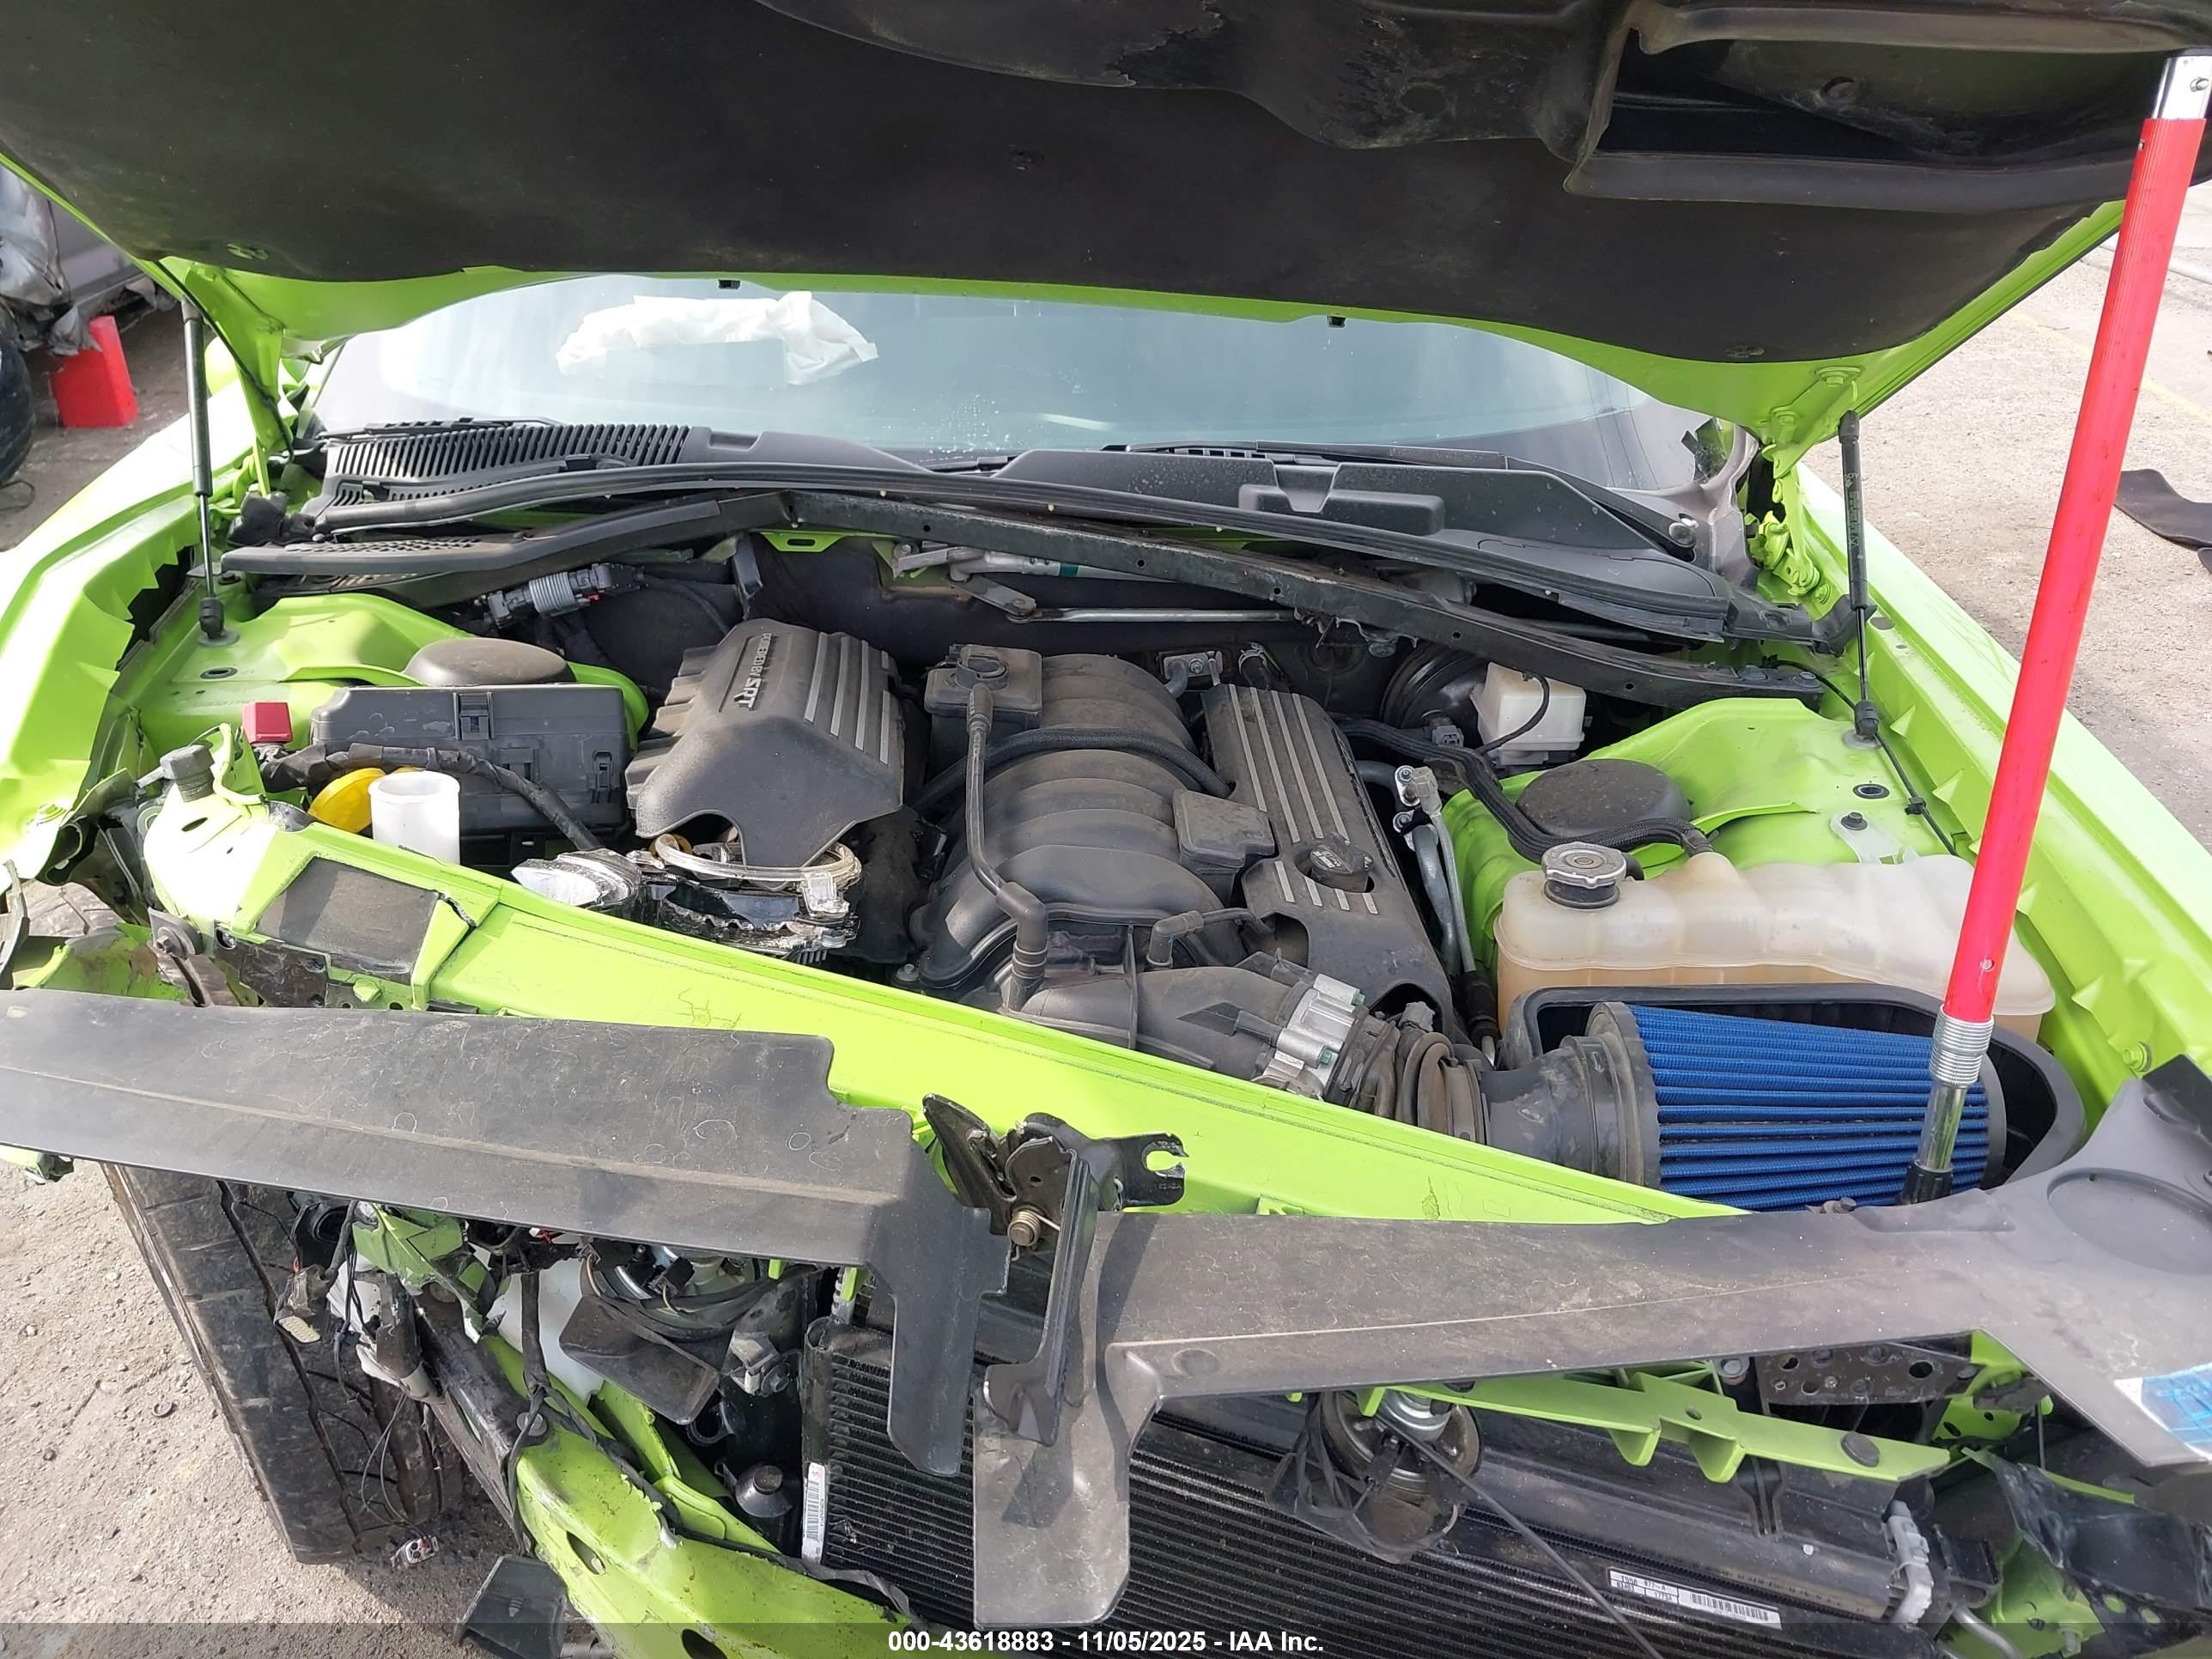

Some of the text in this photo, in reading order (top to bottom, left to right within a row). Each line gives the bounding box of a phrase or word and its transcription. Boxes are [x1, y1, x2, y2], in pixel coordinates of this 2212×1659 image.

[733, 632, 773, 709] POWERED BY SRT
